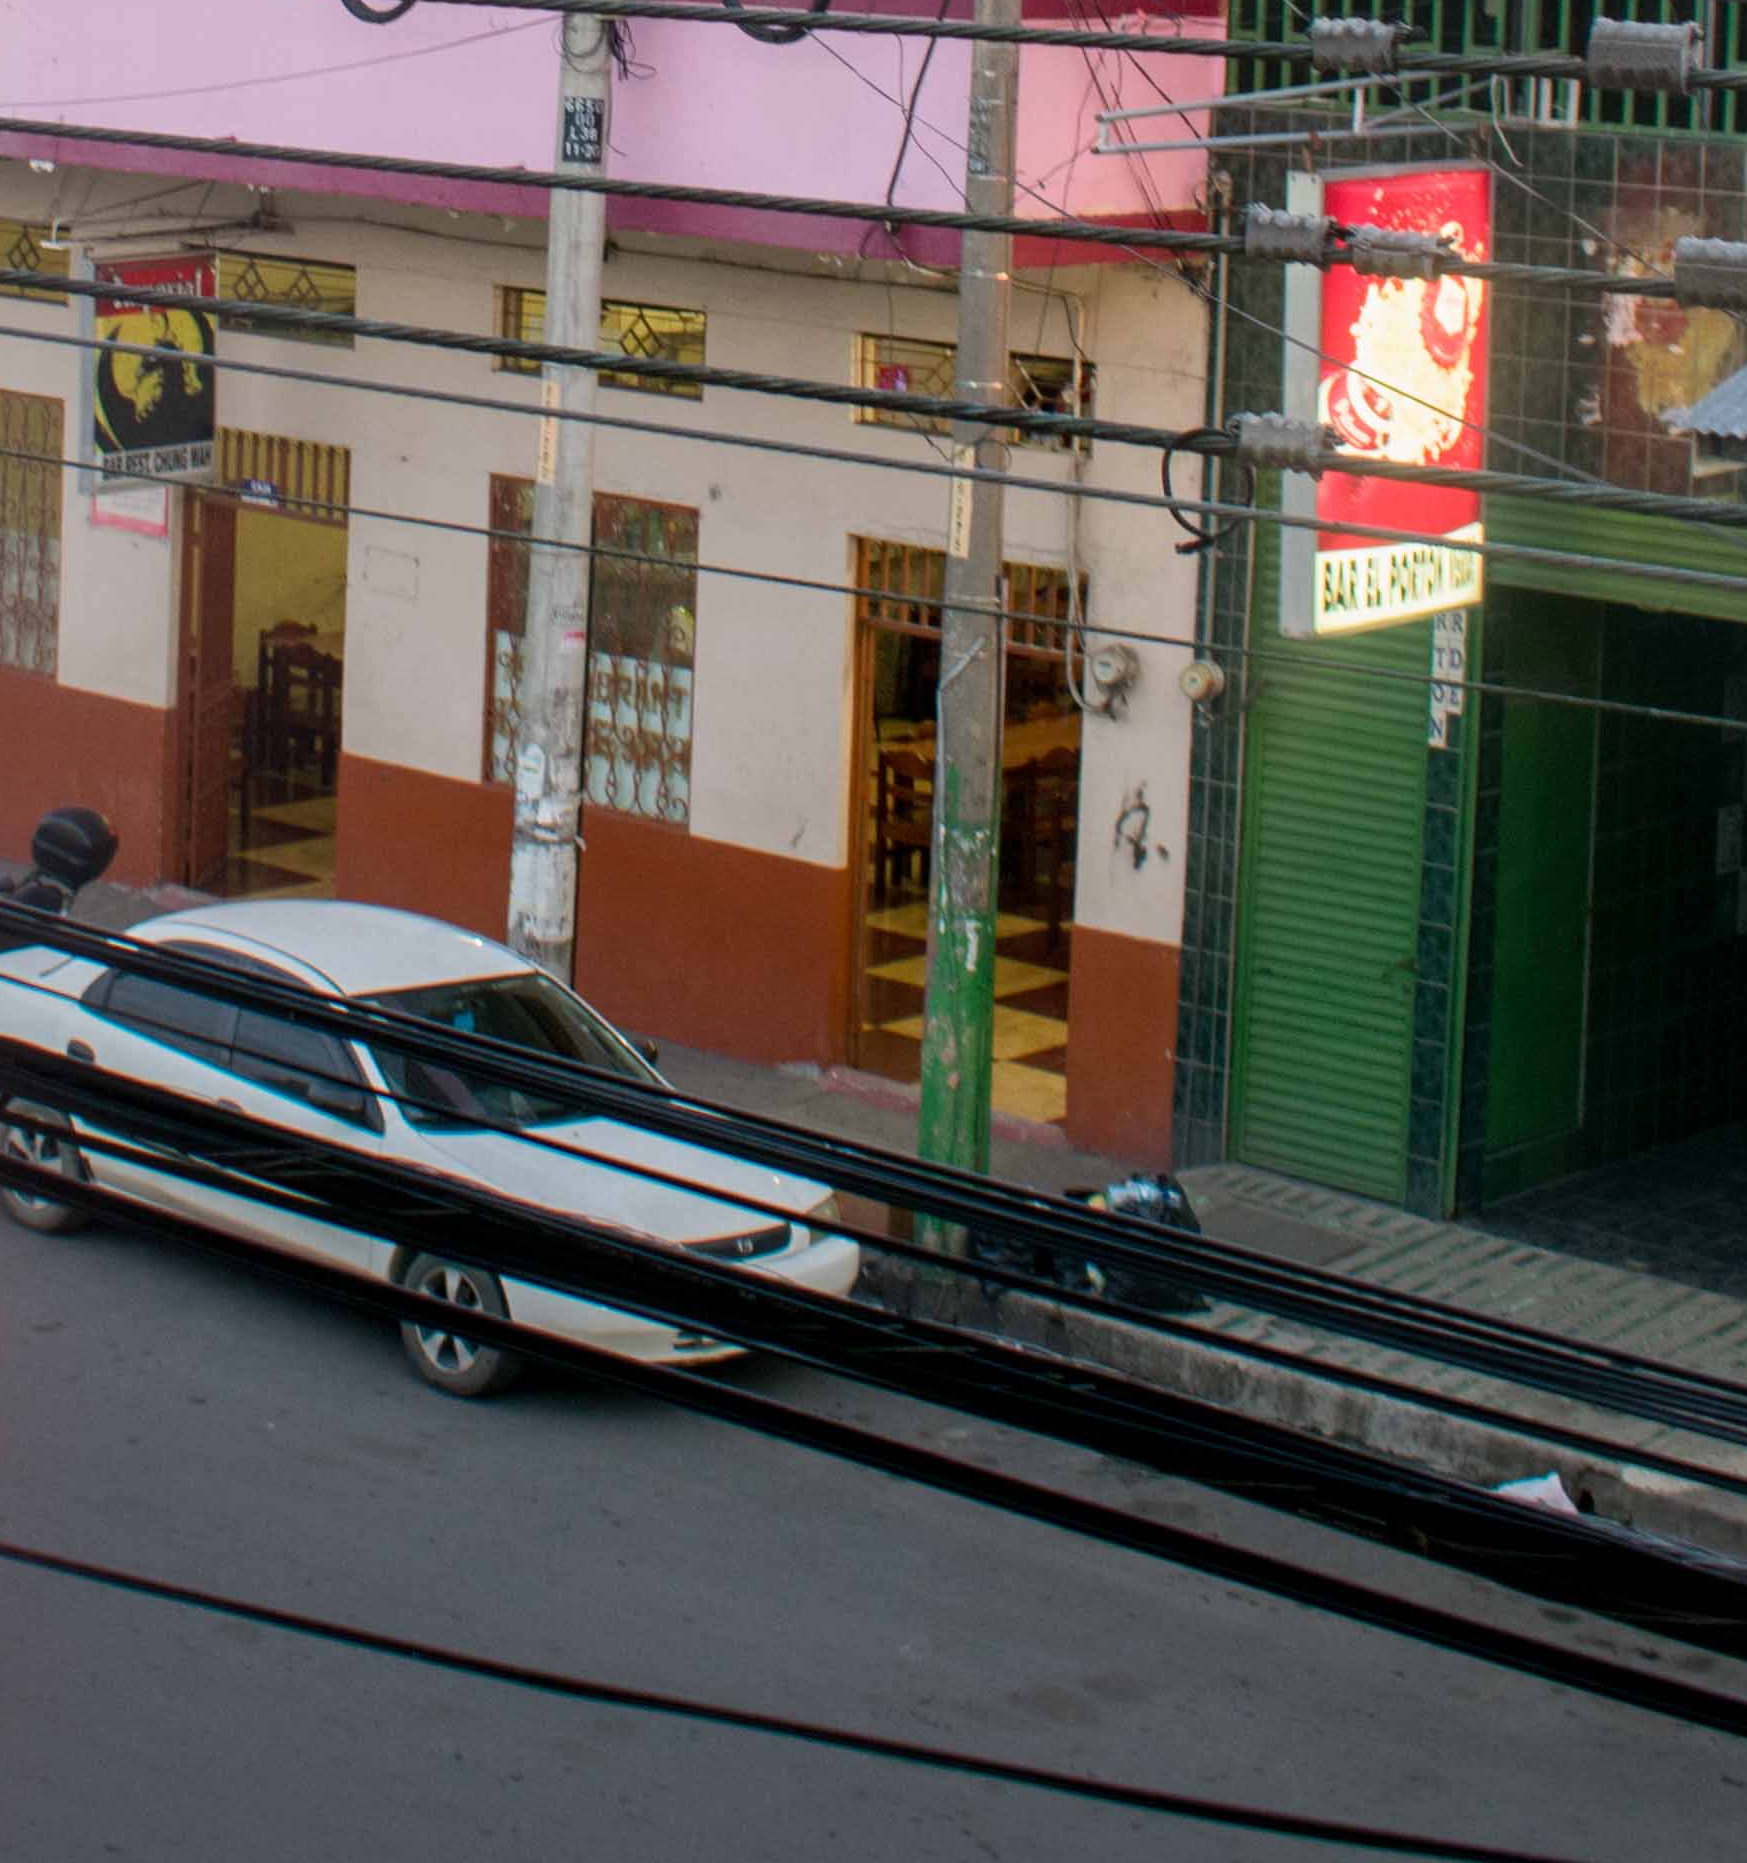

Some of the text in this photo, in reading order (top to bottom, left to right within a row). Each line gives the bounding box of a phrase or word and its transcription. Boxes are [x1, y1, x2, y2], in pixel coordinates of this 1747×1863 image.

[154, 446, 187, 473] CHUNG
[191, 444, 212, 468] WAH
[1323, 558, 1358, 613] BAR
[1366, 556, 1382, 608] EL
